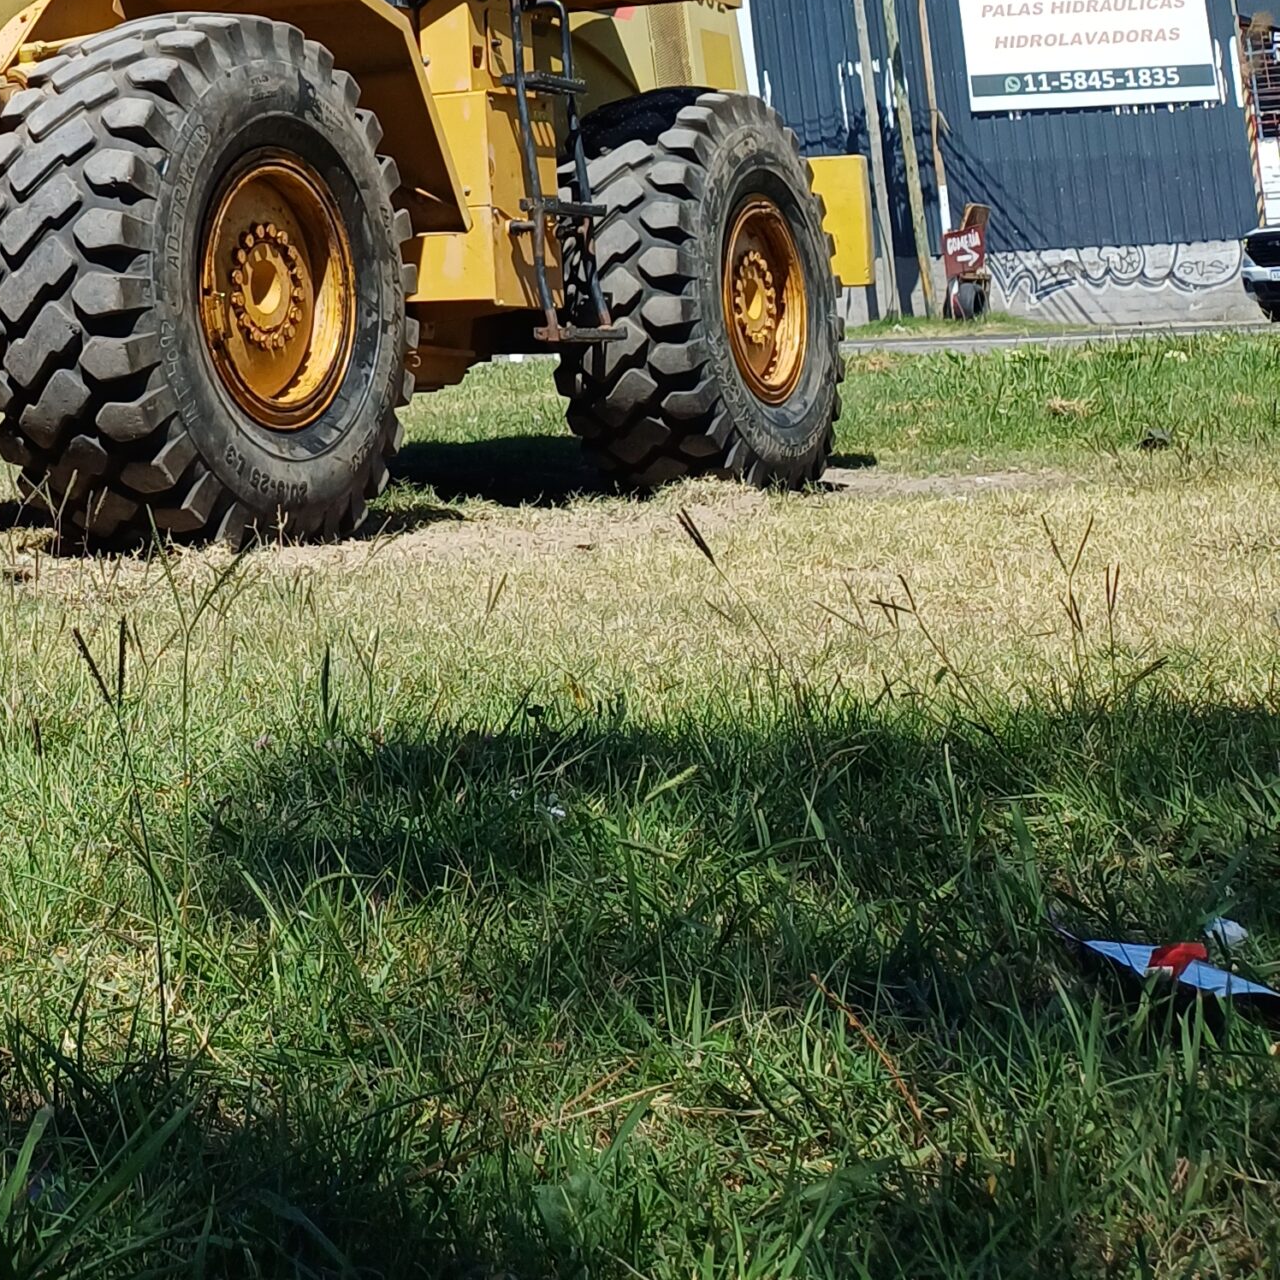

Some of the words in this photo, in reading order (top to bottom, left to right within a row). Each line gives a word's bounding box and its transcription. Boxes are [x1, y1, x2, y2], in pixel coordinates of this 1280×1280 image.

[981, 1, 1044, 18] PALAS
[994, 27, 1181, 49] HIDROLAVADORAS
[1023, 67, 1180, 92] 11-5845-1835
